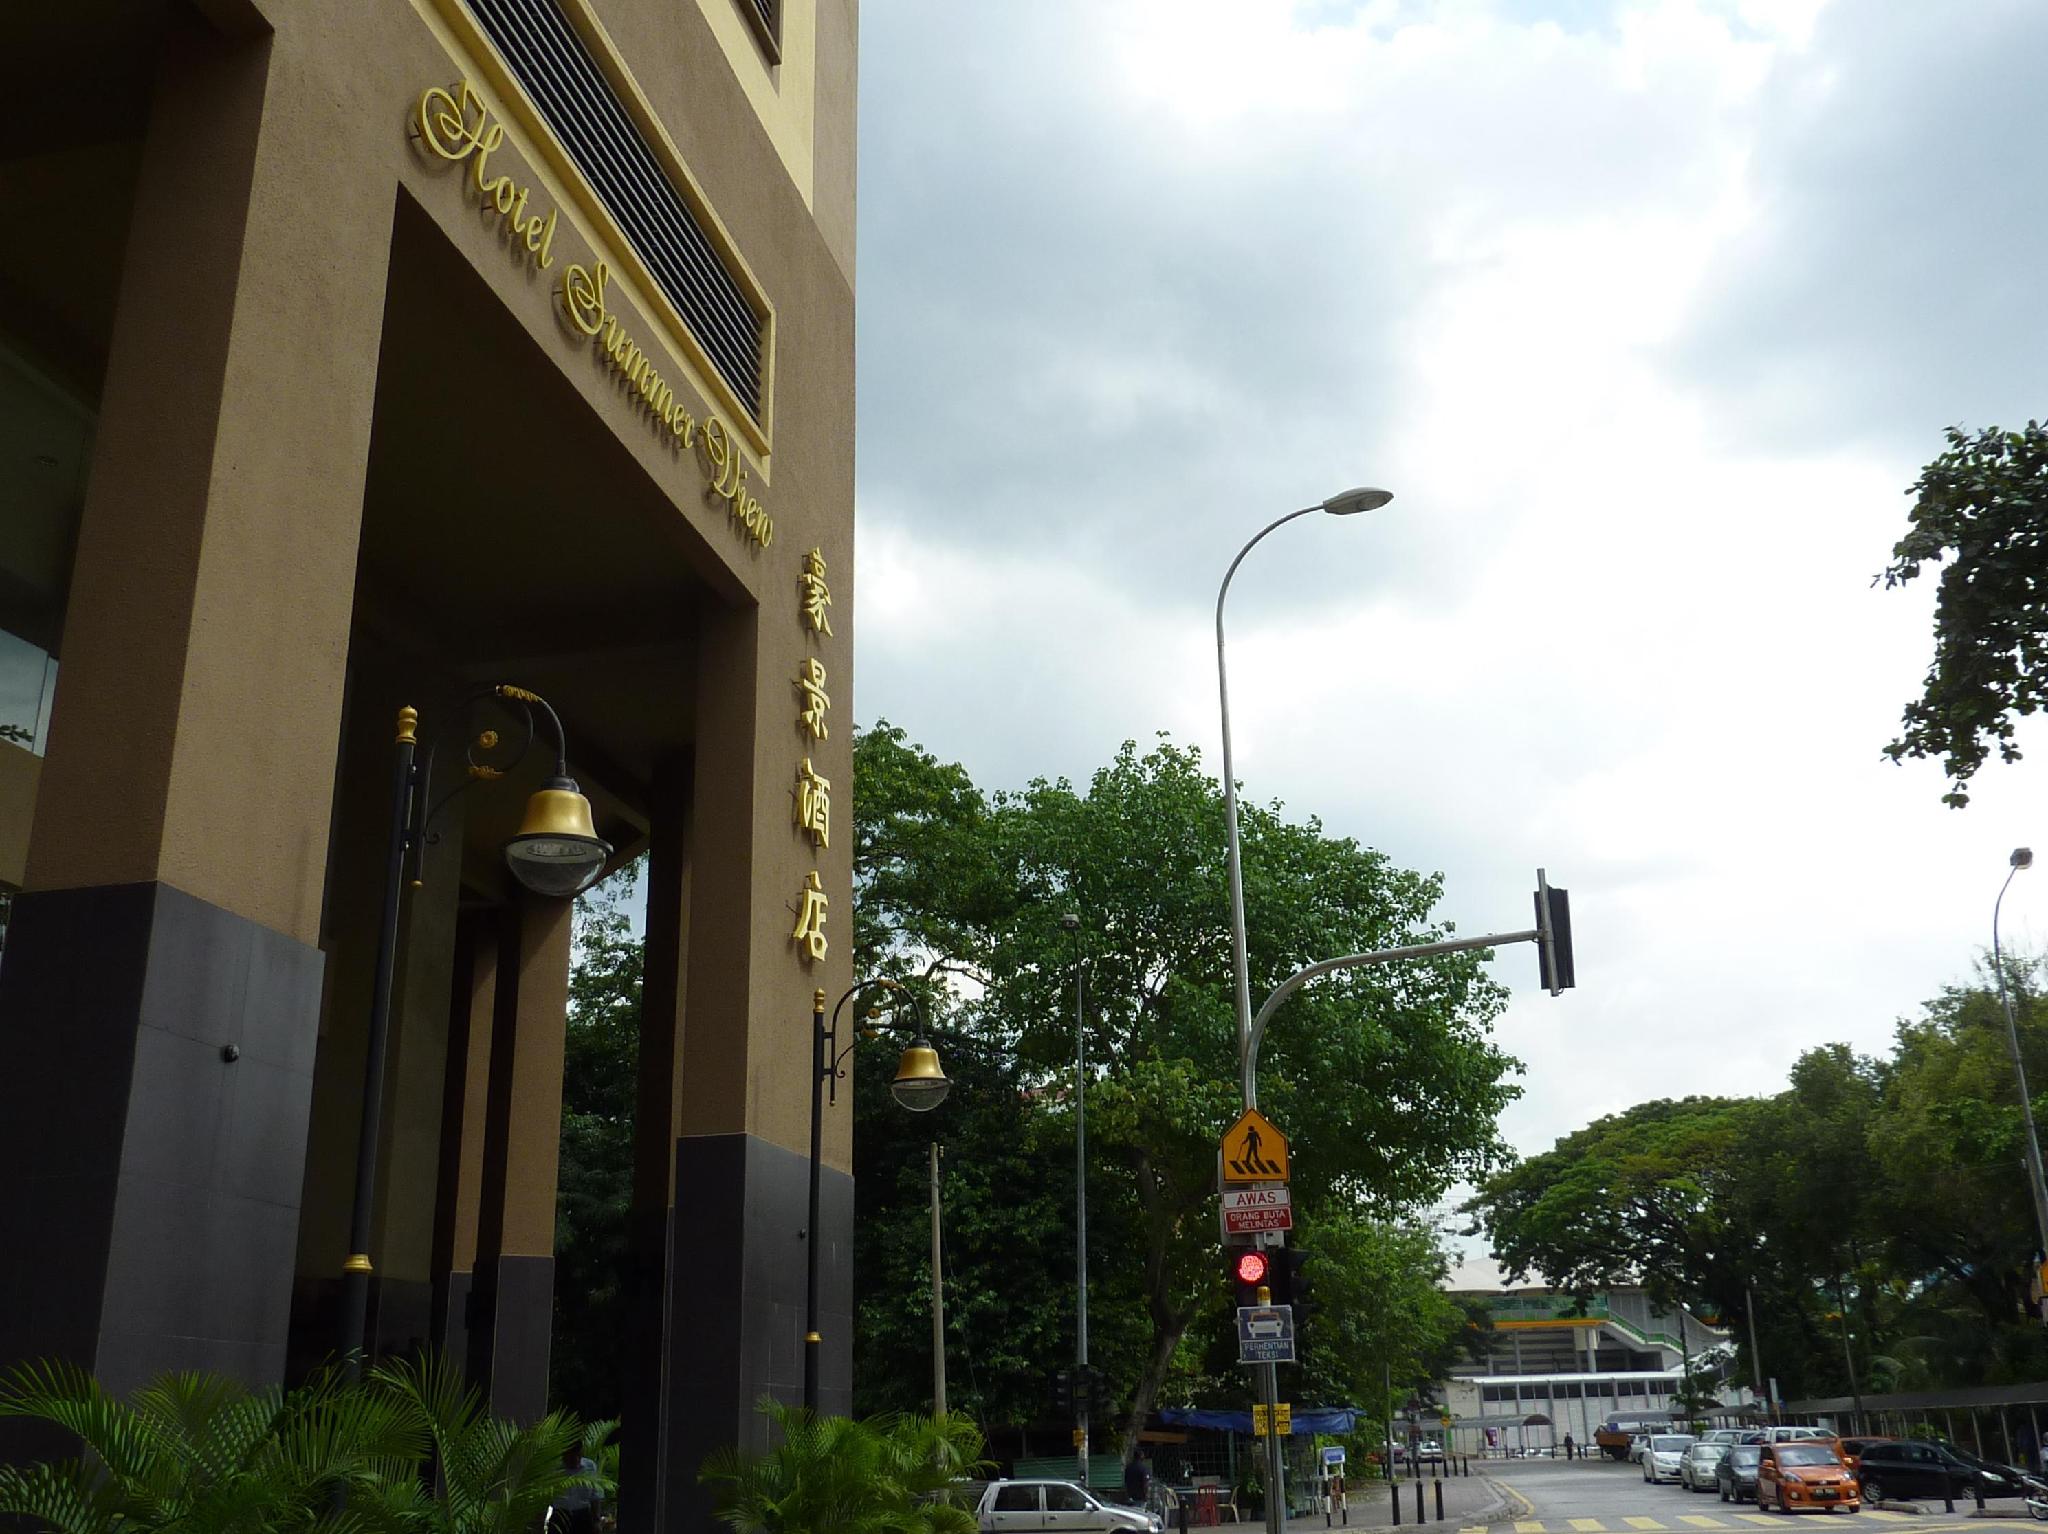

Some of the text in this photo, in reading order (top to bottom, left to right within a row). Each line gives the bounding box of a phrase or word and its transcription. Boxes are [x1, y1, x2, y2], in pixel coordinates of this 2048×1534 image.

[417, 79, 773, 549] Hotel Summer View
[793, 546, 835, 963] 豪景酒店
[1237, 1191, 1276, 1205] AWAS
[1231, 1210, 1286, 1222] ORANG BUTA
[1239, 1220, 1279, 1228] MELINTAS
[1244, 1341, 1289, 1350] PERHENTIAN
[1258, 1351, 1278, 1359] TEKSI
